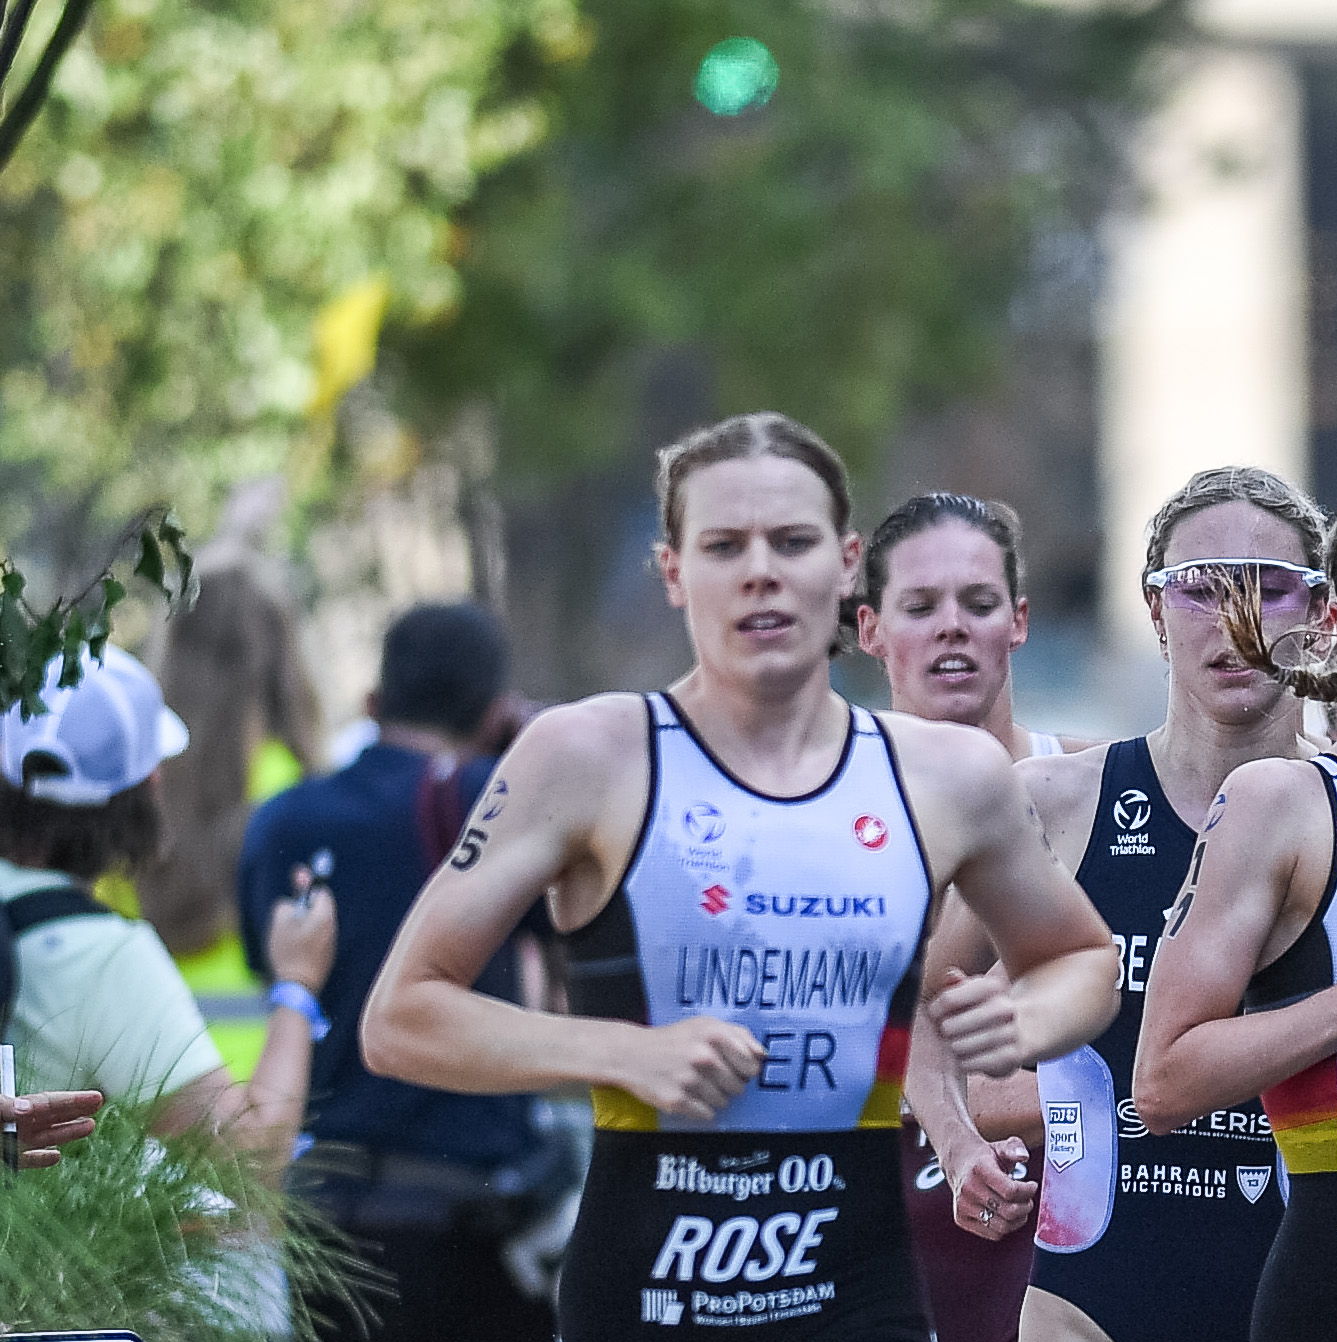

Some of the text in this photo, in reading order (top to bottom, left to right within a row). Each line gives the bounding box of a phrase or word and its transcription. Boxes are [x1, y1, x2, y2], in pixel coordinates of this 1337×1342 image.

[1116, 833, 1149, 844] World
[449, 830, 488, 871] 5
[1109, 845, 1156, 857] Triathlon
[746, 894, 886, 917] SUZUKI
[676, 946, 883, 1009] LINDEMANN
[757, 1028, 838, 1092] ER
[1050, 1130, 1077, 1145] Sport
[656, 1153, 776, 1201] Bitburger
[1121, 1165, 1227, 1185] BAHRAIN
[1121, 1181, 1227, 1199] VICTORIOUS
[650, 1207, 840, 1283] ROSE
